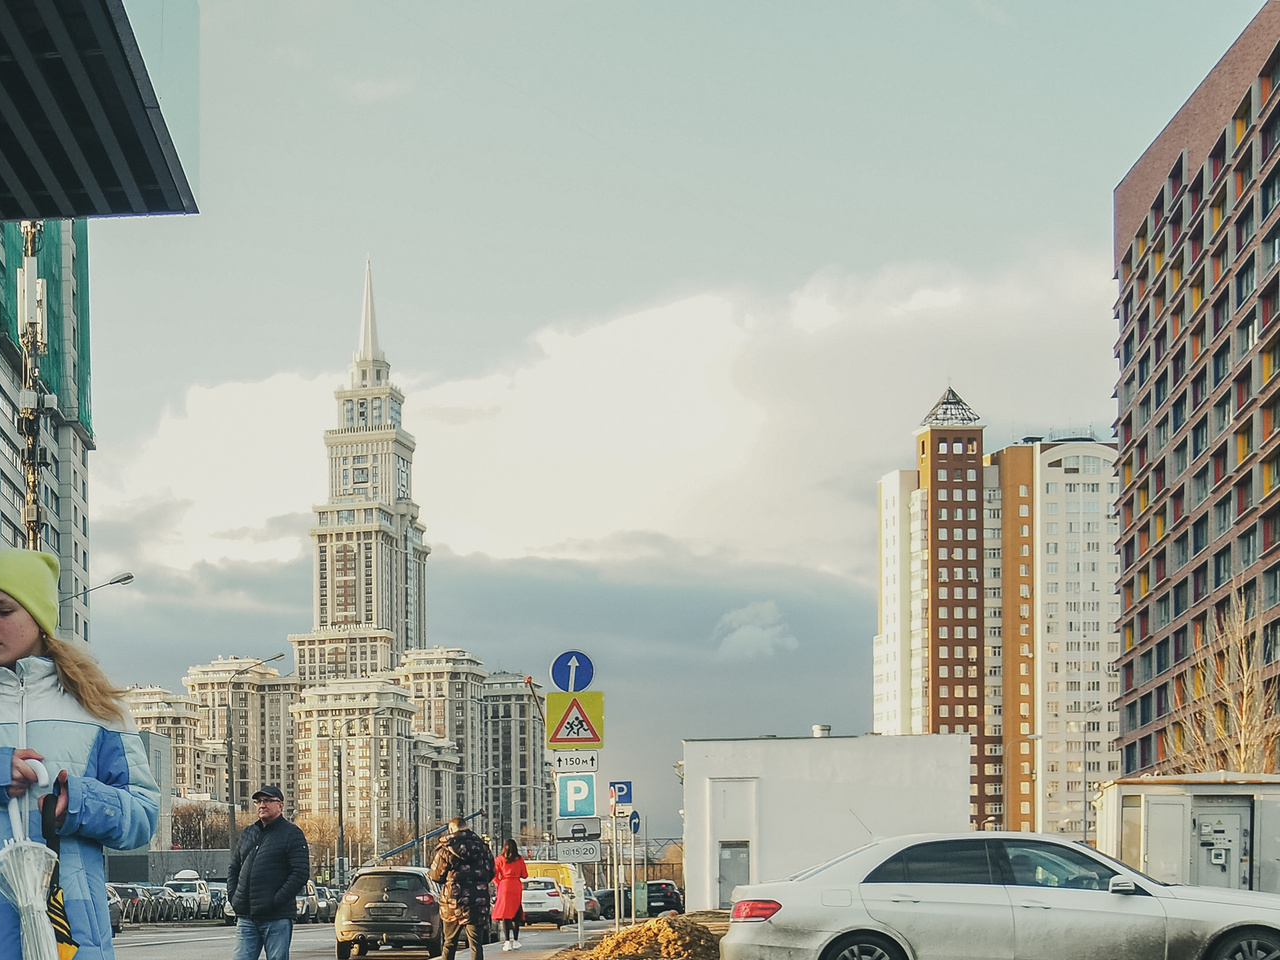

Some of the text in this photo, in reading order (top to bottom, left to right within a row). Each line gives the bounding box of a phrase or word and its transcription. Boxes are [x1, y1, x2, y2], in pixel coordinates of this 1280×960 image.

[566, 779, 589, 812] P
[614, 783, 628, 802] P
[582, 847, 595, 855] 20
